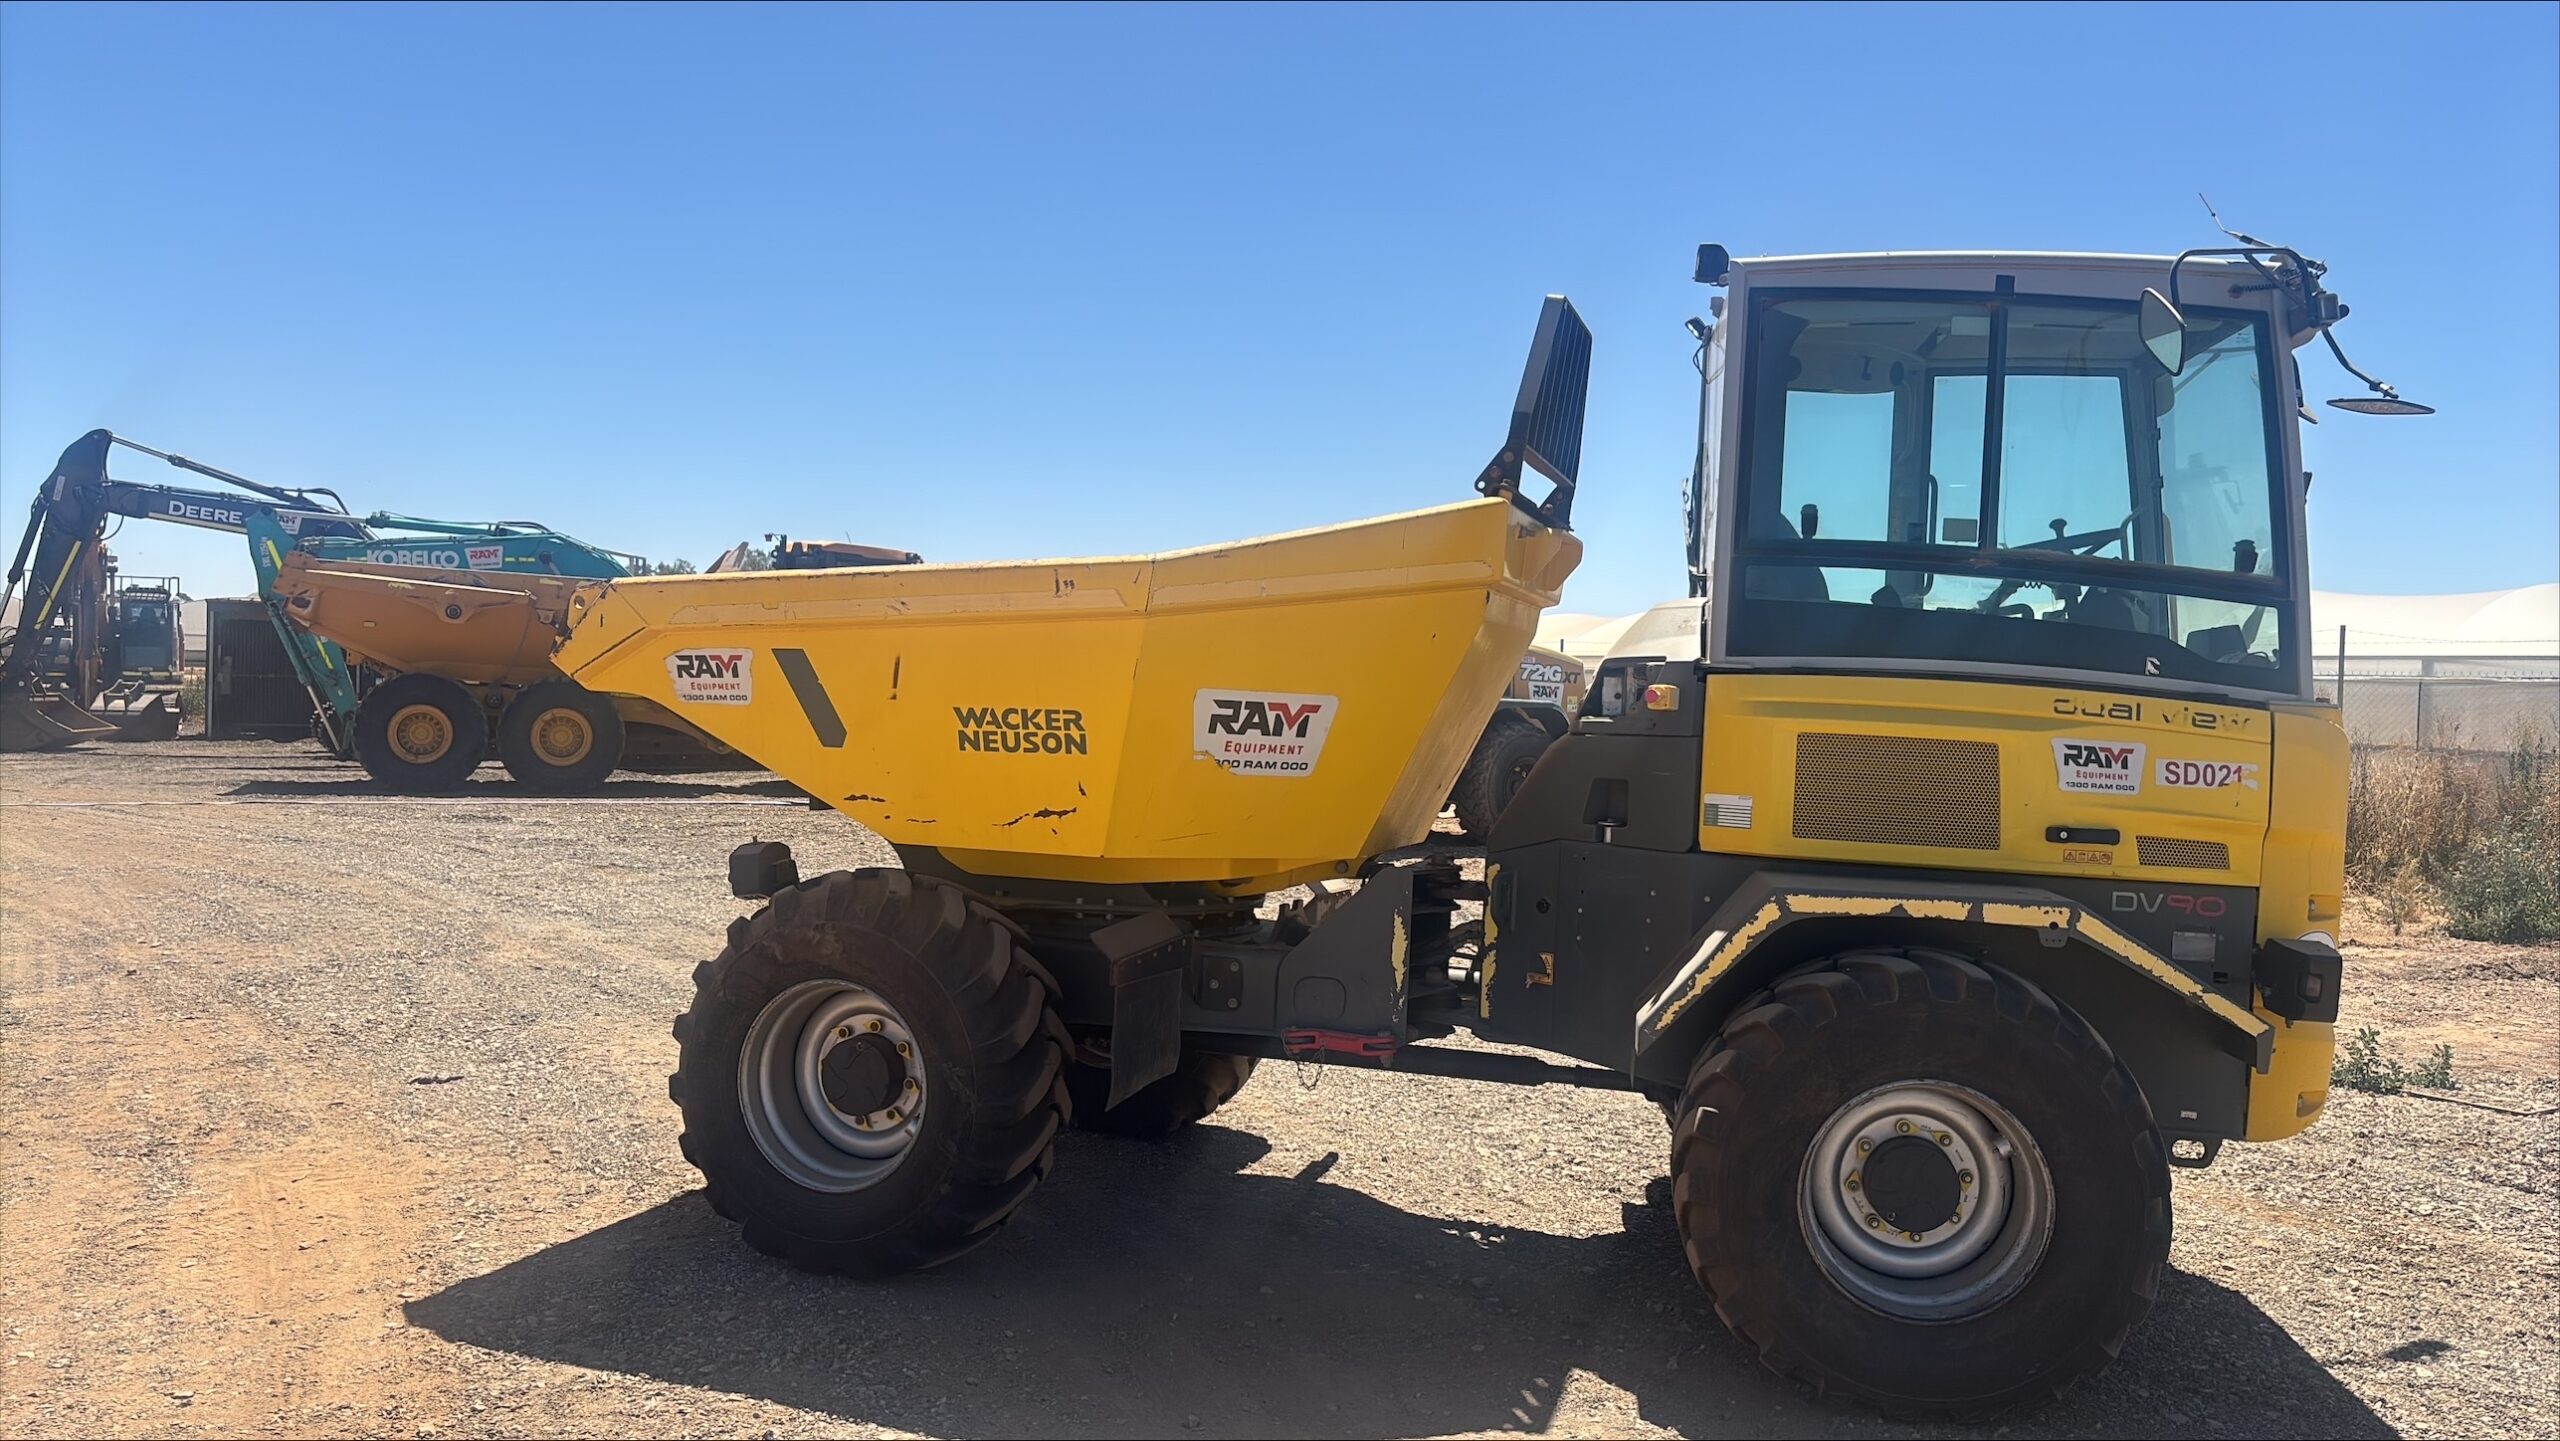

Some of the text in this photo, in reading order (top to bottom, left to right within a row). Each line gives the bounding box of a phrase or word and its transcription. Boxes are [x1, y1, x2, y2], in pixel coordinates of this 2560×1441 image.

[168, 500, 243, 524] DEERE
[367, 549, 461, 568] KOBELCO
[469, 549, 500, 560] RAM
[675, 655, 743, 678] RAM
[690, 682, 741, 691] EQUIPMENT
[1532, 686, 1559, 698] RAM
[952, 706, 1086, 731] WACKER
[1208, 699, 1322, 738] RAM
[957, 730, 1087, 755] NEUSON
[1224, 741, 1304, 755] EQUIPMENT
[1243, 760, 1277, 770] RAM
[1280, 761, 1308, 770] 000
[2063, 744, 2135, 769] RAM
[2076, 770, 2129, 780] EQUIPMENT
[2164, 761, 2242, 787] SD021
[2111, 891, 2227, 917] DV90
